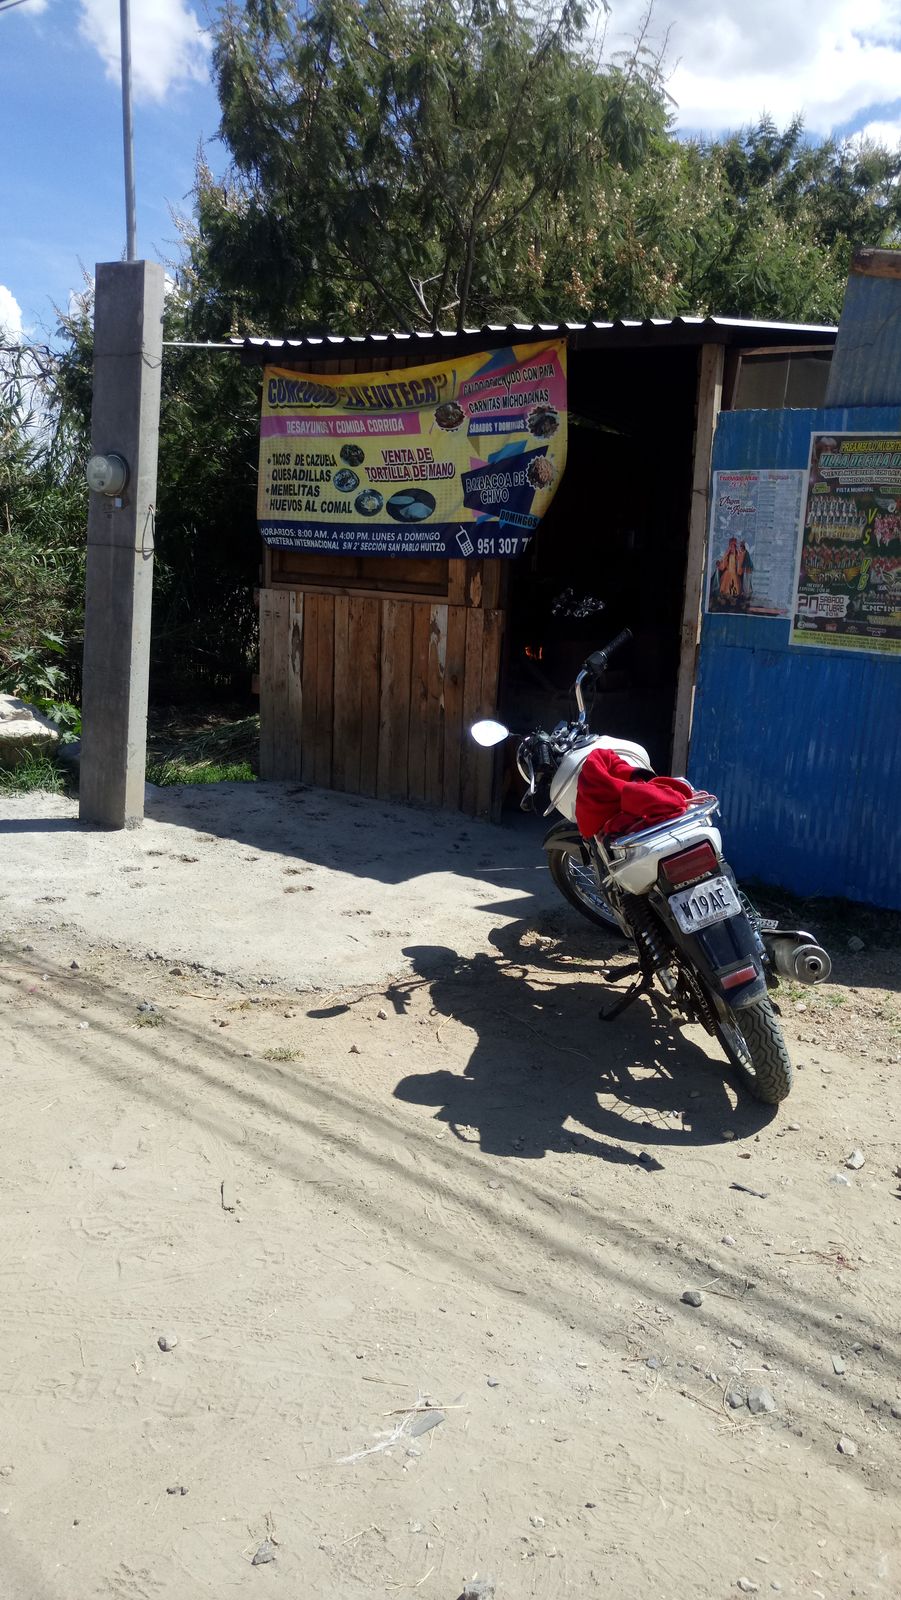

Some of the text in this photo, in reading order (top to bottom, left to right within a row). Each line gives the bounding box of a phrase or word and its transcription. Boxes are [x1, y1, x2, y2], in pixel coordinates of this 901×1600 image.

[522, 366, 538, 382] CON
[468, 389, 549, 413] CARNITAS MICHOACANAS
[286, 418, 405, 434] DESAYUNOS Y COMIDA CORRIDA
[272, 453, 338, 467] TACOS DE CAZUELA
[381, 447, 434, 465] VENTA DE
[820, 453, 849, 468] VILLA
[271, 469, 332, 482] QUESADILLAS
[364, 462, 455, 482] TORTILLA DE MANO
[465, 470, 526, 493] BARBACOA DE
[270, 484, 321, 497] MEMELITAS
[480, 488, 510, 504] CHIVO
[269, 499, 353, 514] HUEVOS AL COMAL
[500, 510, 538, 528] DOMINGOS
[260, 528, 297, 538] HORARIOS:
[297, 529, 313, 538] 8:00
[332, 531, 338, 539] A
[339, 531, 355, 540] 4:00
[371, 532, 395, 541] LUNES
[396, 533, 403, 541] A
[404, 532, 441, 541] DOMINGO
[294, 539, 339, 550] INTERNACIONAL
[387, 543, 401, 551] SAN
[401, 543, 419, 551] PABLO
[420, 542, 446, 552] HUITZO
[477, 537, 533, 554] 951 307 7
[819, 595, 845, 604] SABADO
[818, 604, 845, 613] OCTUBRE
